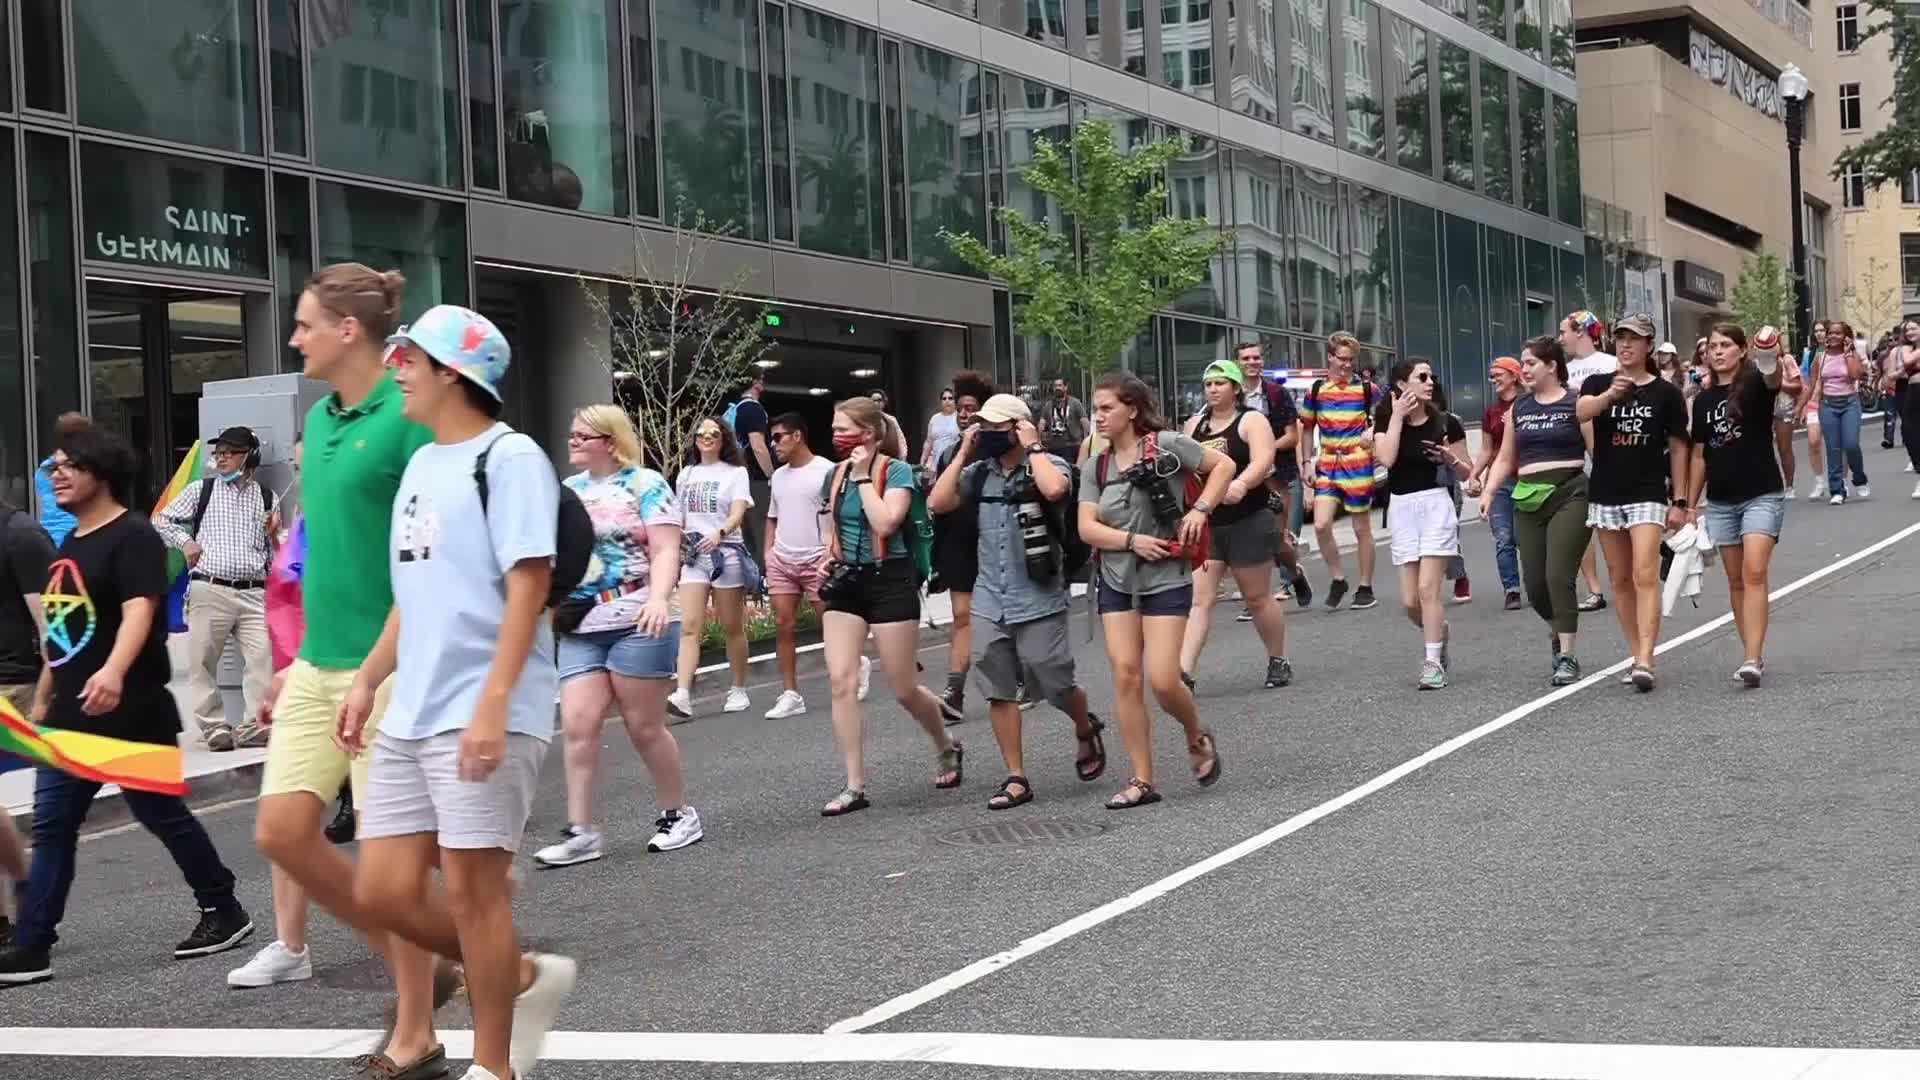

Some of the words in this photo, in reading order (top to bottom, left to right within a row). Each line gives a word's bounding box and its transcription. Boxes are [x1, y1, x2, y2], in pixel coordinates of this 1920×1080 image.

[96, 231, 230, 269] GERMAIN
[1611, 405, 1617, 417] I
[1621, 406, 1652, 418] LIKE
[1706, 411, 1711, 423] I
[1616, 419, 1643, 433] HER
[1611, 433, 1651, 446] BUTT
